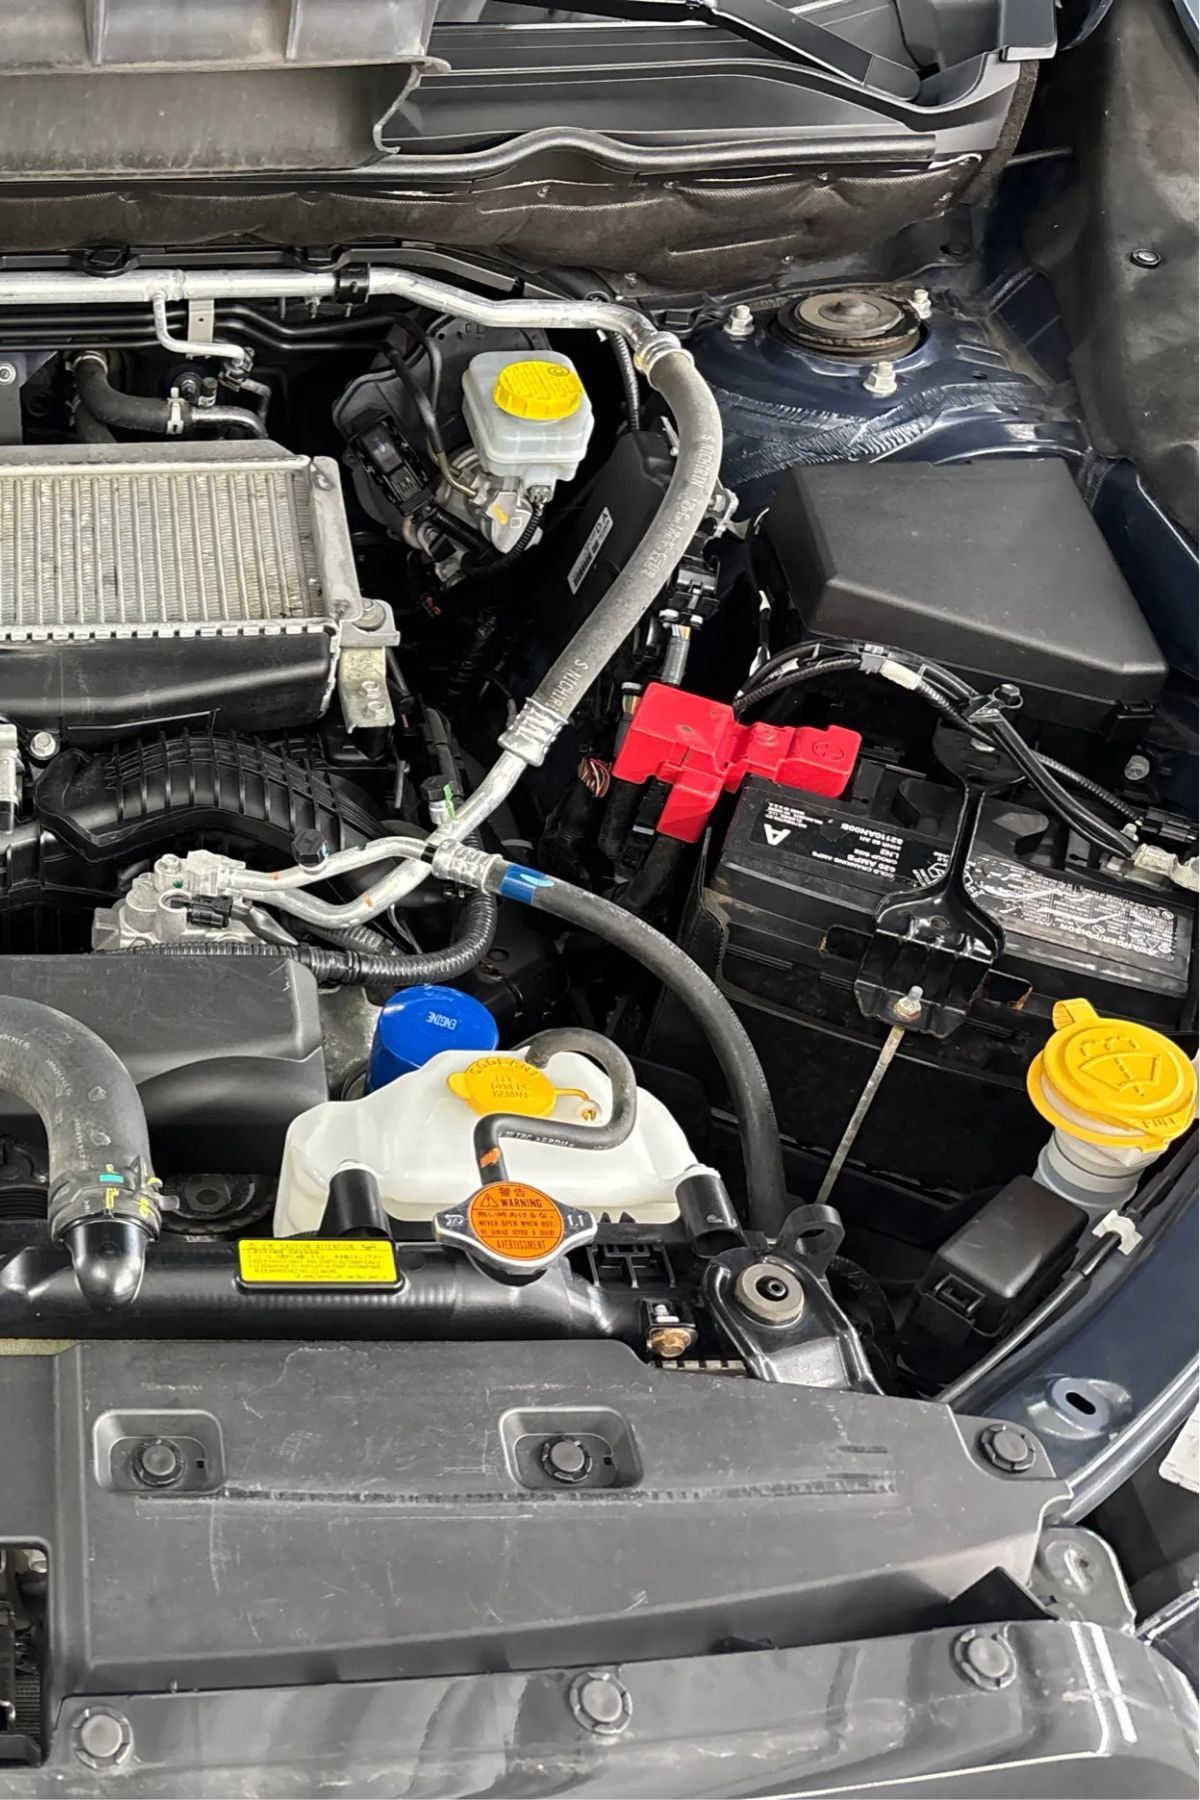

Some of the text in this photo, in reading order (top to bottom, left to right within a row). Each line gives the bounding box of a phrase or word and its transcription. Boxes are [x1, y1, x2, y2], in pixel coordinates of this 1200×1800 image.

[544, 659, 589, 711] S NICHIRI
[763, 823, 792, 846] A
[840, 822, 904, 845] 82110AN00B
[847, 854, 897, 873] 620 AMPS
[880, 848, 900, 860] LN2
[833, 857, 873, 873] CRANKING
[426, 1011, 457, 1031] ENGINE
[500, 1198, 543, 1208] WARNING
